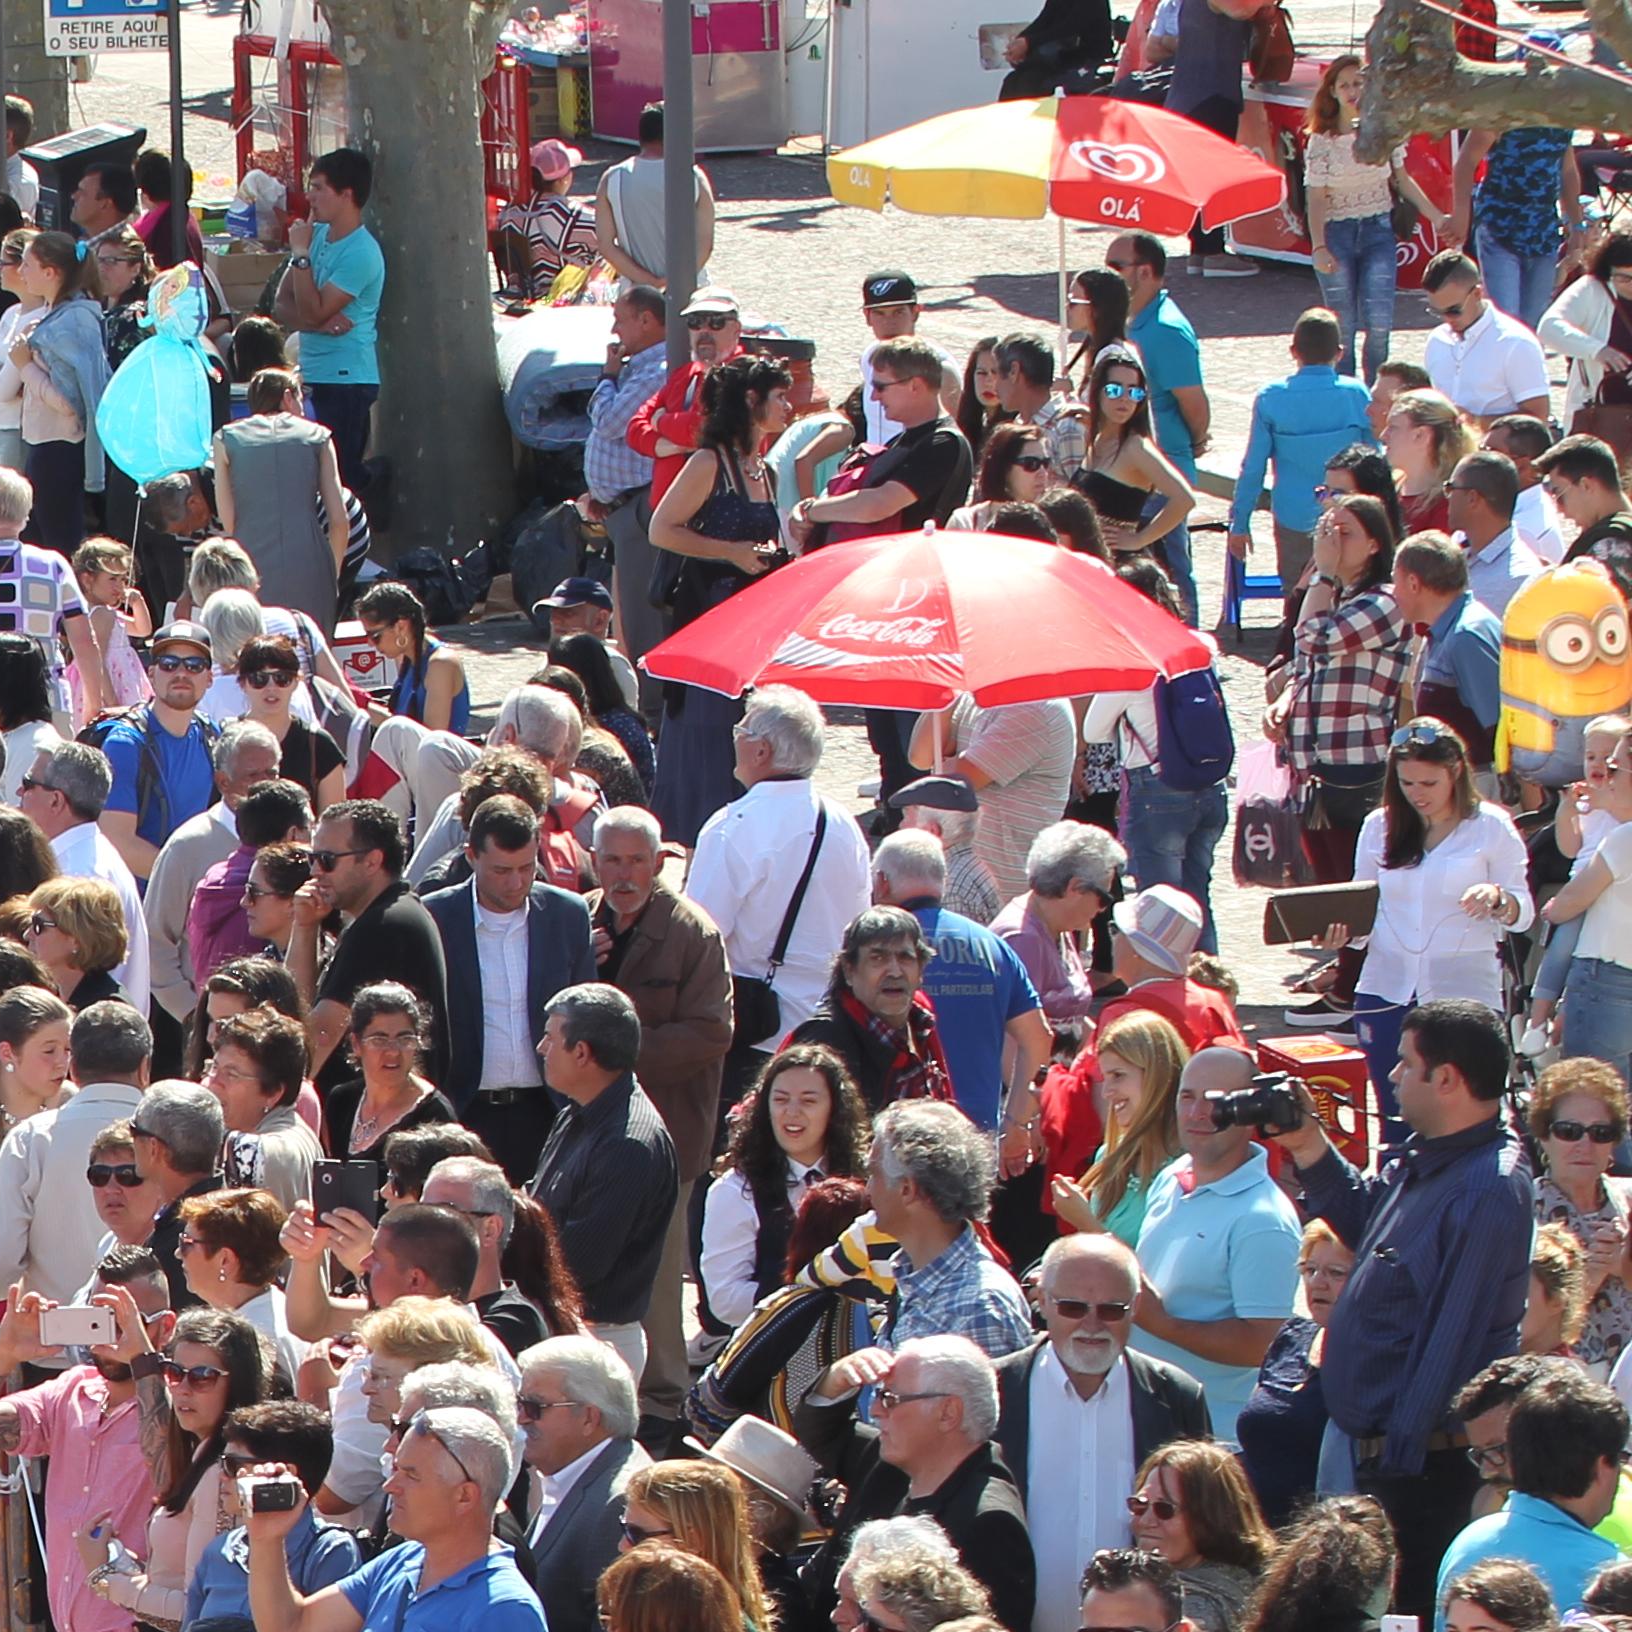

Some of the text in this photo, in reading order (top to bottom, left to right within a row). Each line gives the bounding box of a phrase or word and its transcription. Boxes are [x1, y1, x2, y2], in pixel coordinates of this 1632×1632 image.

[60, 20, 158, 35] RETIRE AQUI
[49, 34, 169, 50] O SEU BILHETE
[1099, 196, 1142, 223] OLÁ
